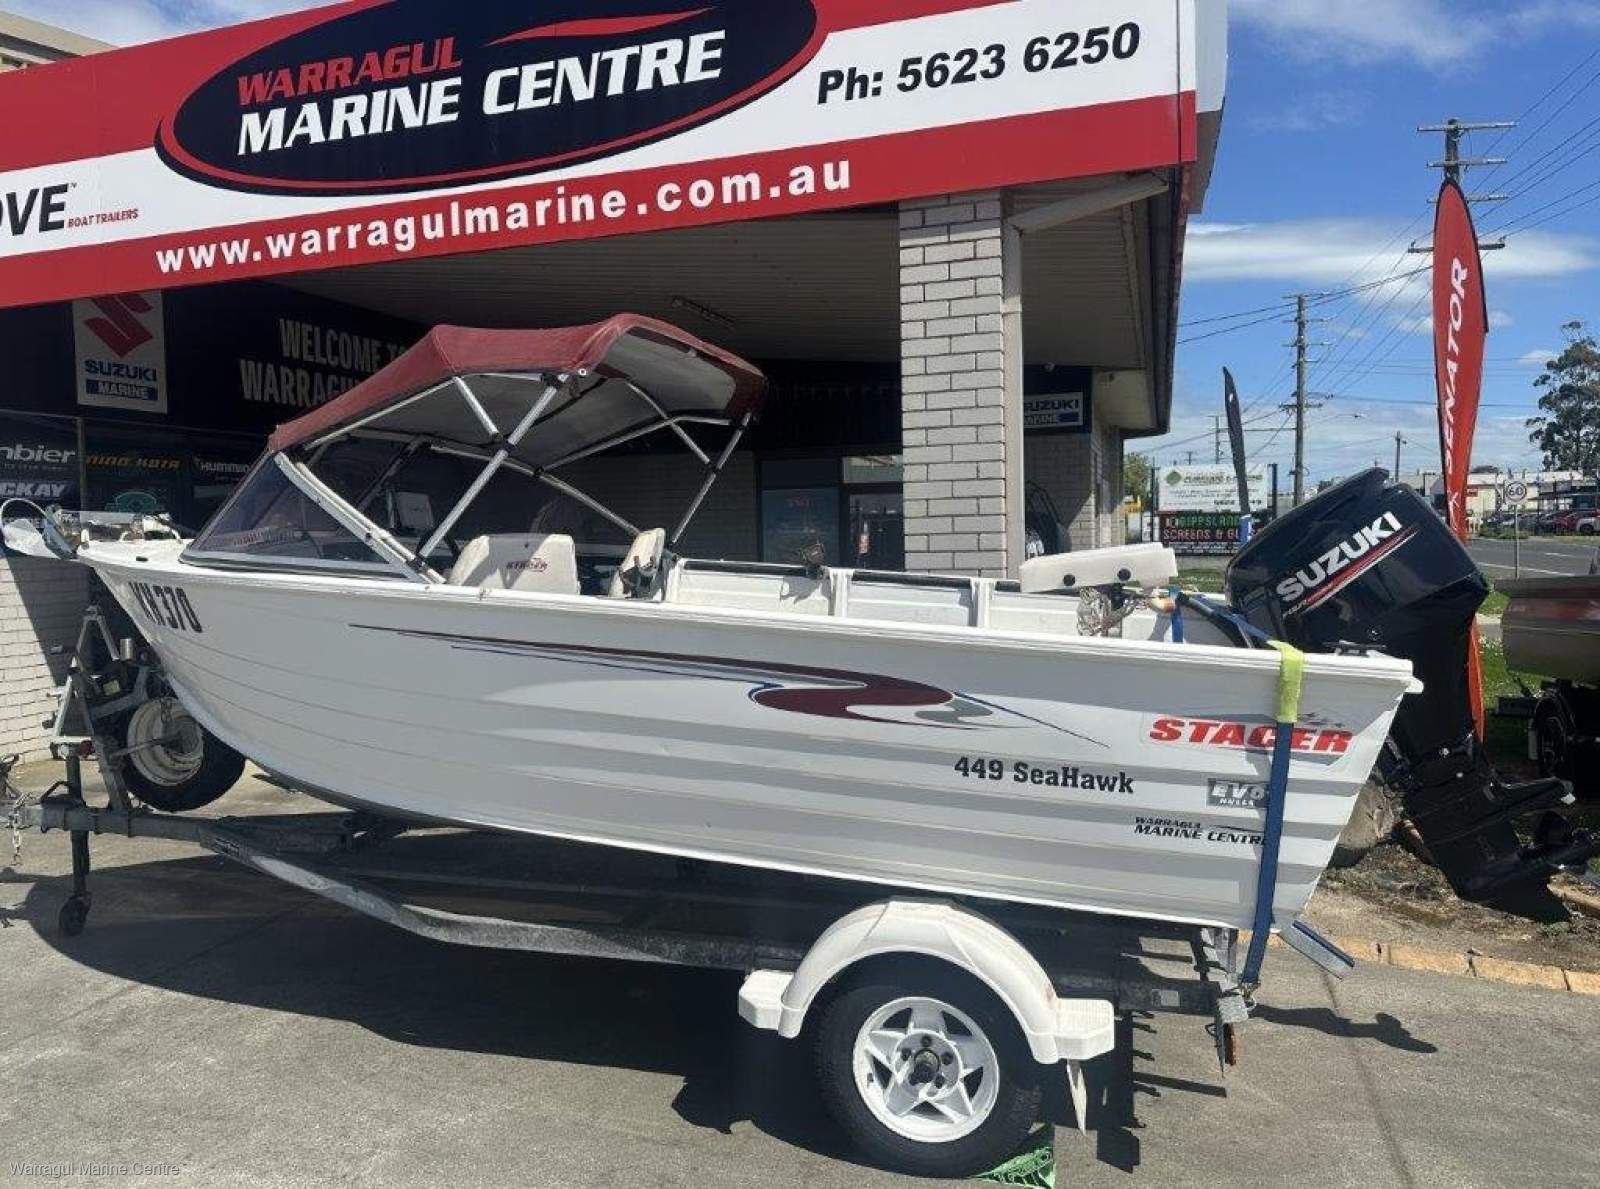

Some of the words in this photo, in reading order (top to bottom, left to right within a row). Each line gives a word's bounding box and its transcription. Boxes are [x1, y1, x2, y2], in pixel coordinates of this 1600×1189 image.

[237, 36, 463, 106] WARRAGUL
[817, 67, 884, 105] Ph:
[897, 43, 1006, 92] 5623
[1023, 22, 1140, 73] 6250
[237, 77, 462, 156] MARINE
[483, 30, 726, 115] CENTRE
[0, 182, 68, 236] VE
[68, 215, 94, 229] BOAT
[96, 208, 139, 225] TRAILERS
[155, 159, 850, 273] www.warragulmarine.com.au
[84, 359, 158, 382] SUZUKI
[279, 318, 383, 373] WELCOME
[1443, 257, 1468, 476] SENATOR
[0, 482, 65, 497] CKAY
[1508, 483, 1524, 497] 60
[1276, 511, 1402, 601] SUZUKI
[954, 756, 1004, 781] 449
[1013, 761, 1135, 794] SeaHawk
[1133, 824, 1203, 840] MARINE
[1207, 831, 1267, 846] CENTR
